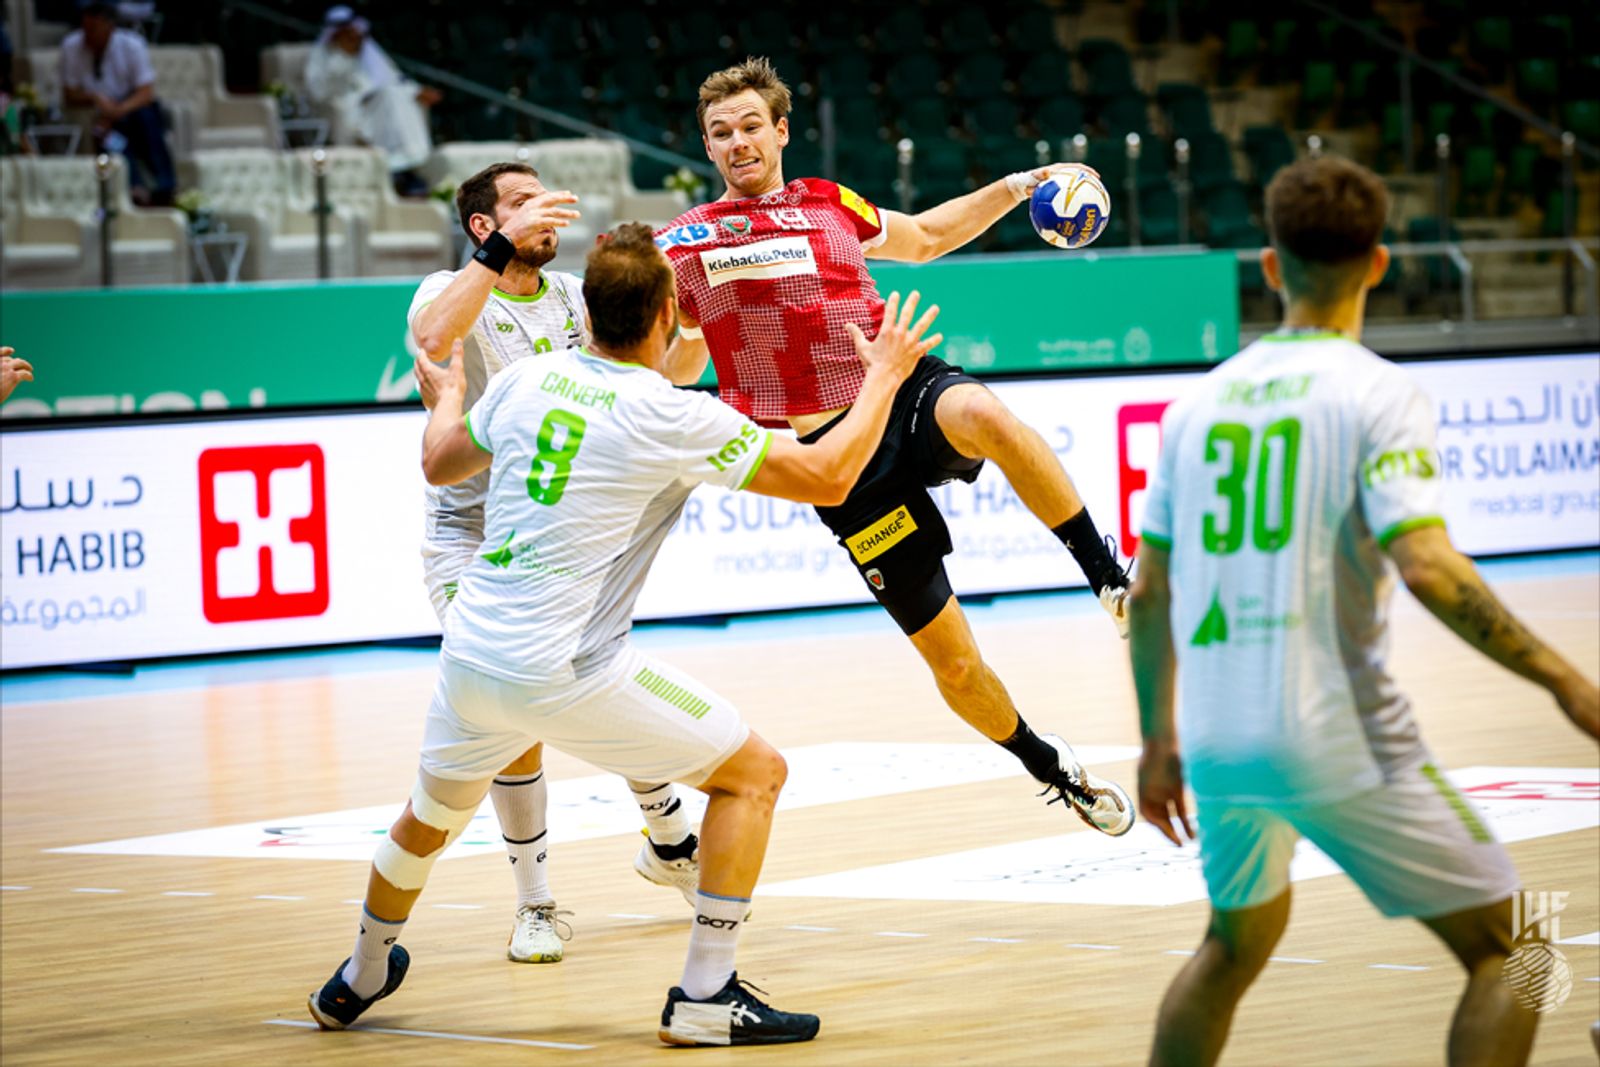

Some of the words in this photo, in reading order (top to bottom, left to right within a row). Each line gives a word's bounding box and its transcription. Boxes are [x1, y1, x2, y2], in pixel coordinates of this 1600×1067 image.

[708, 248, 808, 272] Kieback&Peter
[540, 371, 617, 411] CANEPA
[526, 408, 587, 506] 8
[1437, 446, 1464, 480] R
[1472, 438, 1600, 480] SULAIMA
[1202, 417, 1304, 556] 30
[17, 529, 146, 577] HABIB
[696, 914, 739, 931] GO7
